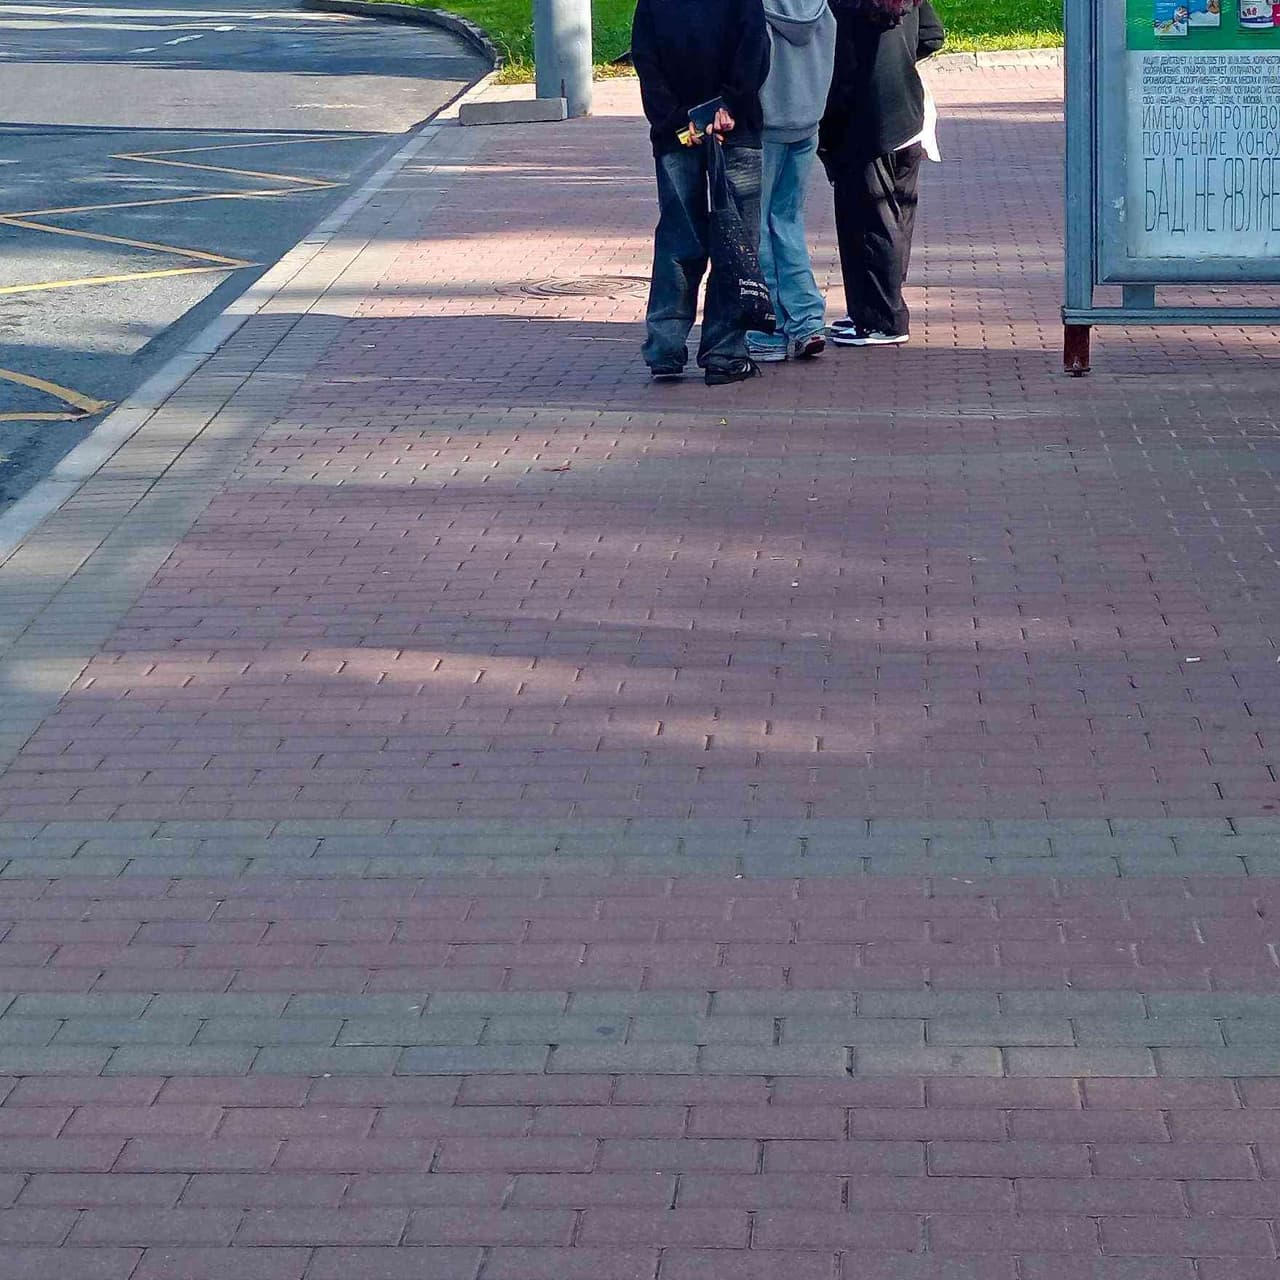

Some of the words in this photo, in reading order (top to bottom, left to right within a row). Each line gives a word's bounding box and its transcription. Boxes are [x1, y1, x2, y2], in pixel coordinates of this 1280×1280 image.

[1143, 105, 1209, 130] ИМЕЮТСЯ
[1143, 131, 1227, 156] ПОЛУЧЕНИЕ
[1195, 158, 1217, 232] НЕ
